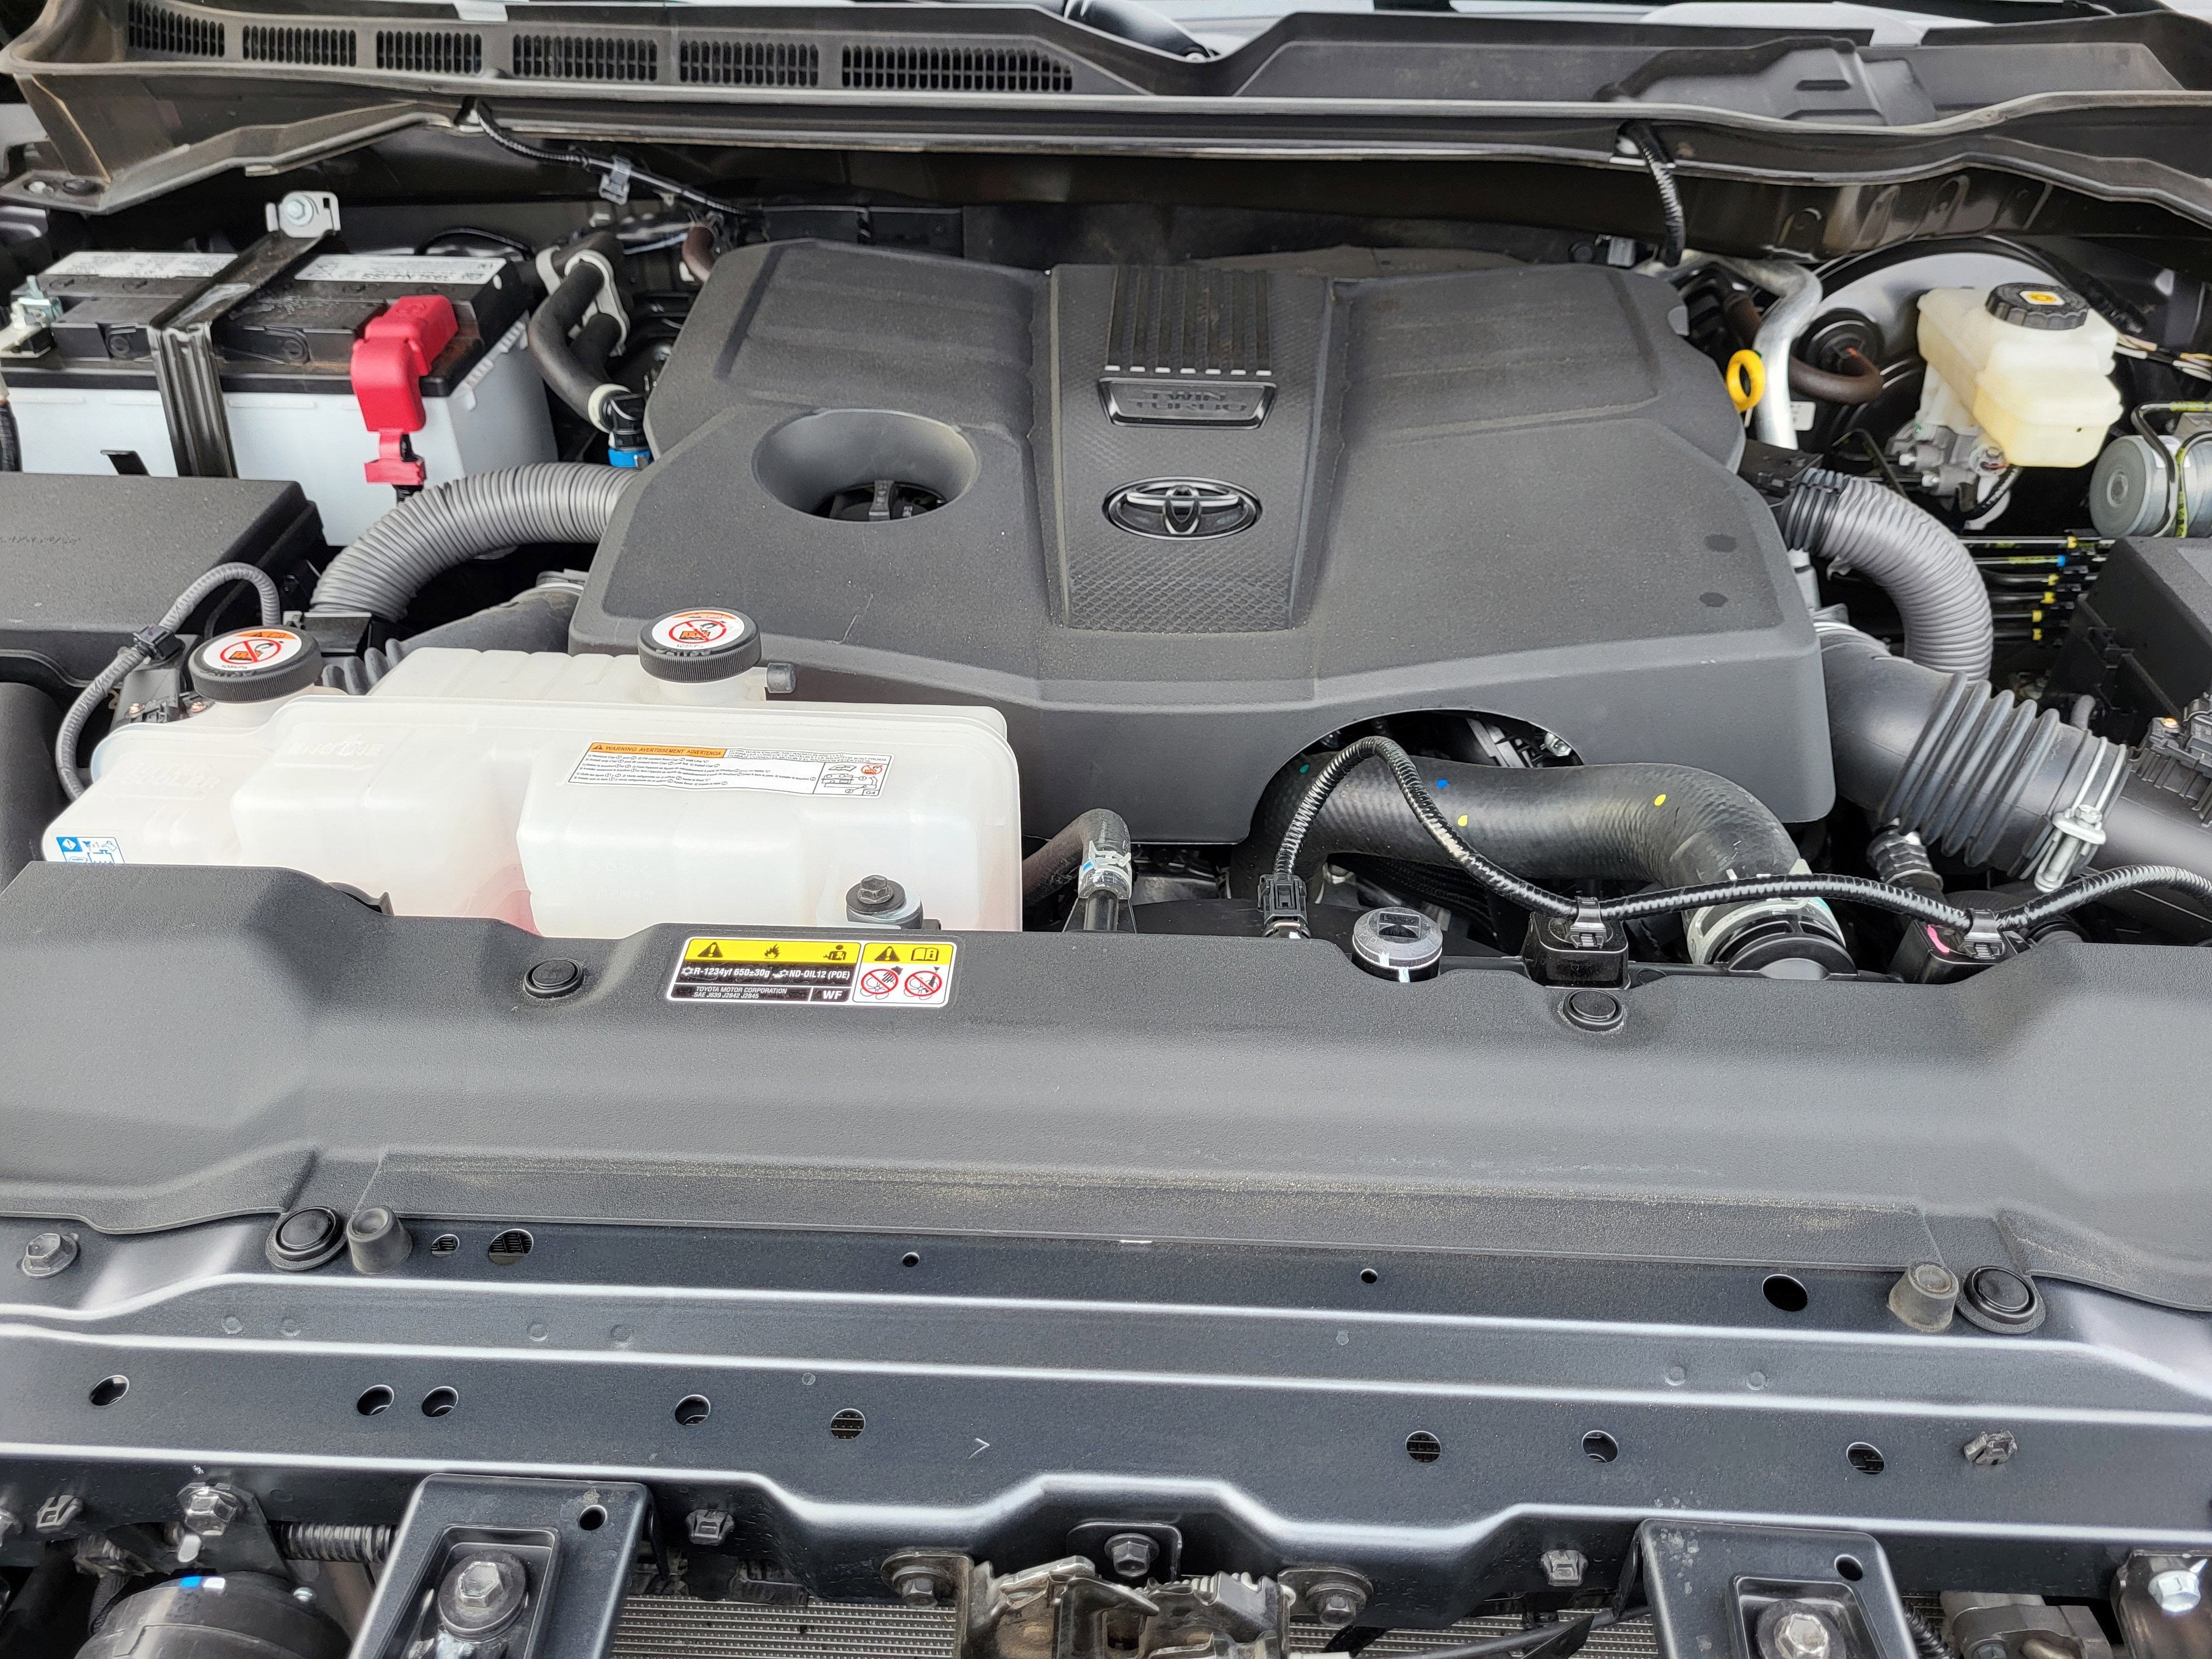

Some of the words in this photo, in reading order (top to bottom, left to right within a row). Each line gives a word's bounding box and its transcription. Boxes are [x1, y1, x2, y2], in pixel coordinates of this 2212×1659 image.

[1142, 389, 1227, 400] TWIN
[1127, 398, 1246, 412] TURBO
[693, 967, 733, 978] R-1234yf
[733, 968, 770, 978] 650±30g
[789, 969, 827, 978] ND-OIL12
[827, 971, 851, 980] (POE)
[823, 990, 843, 1000] WF
